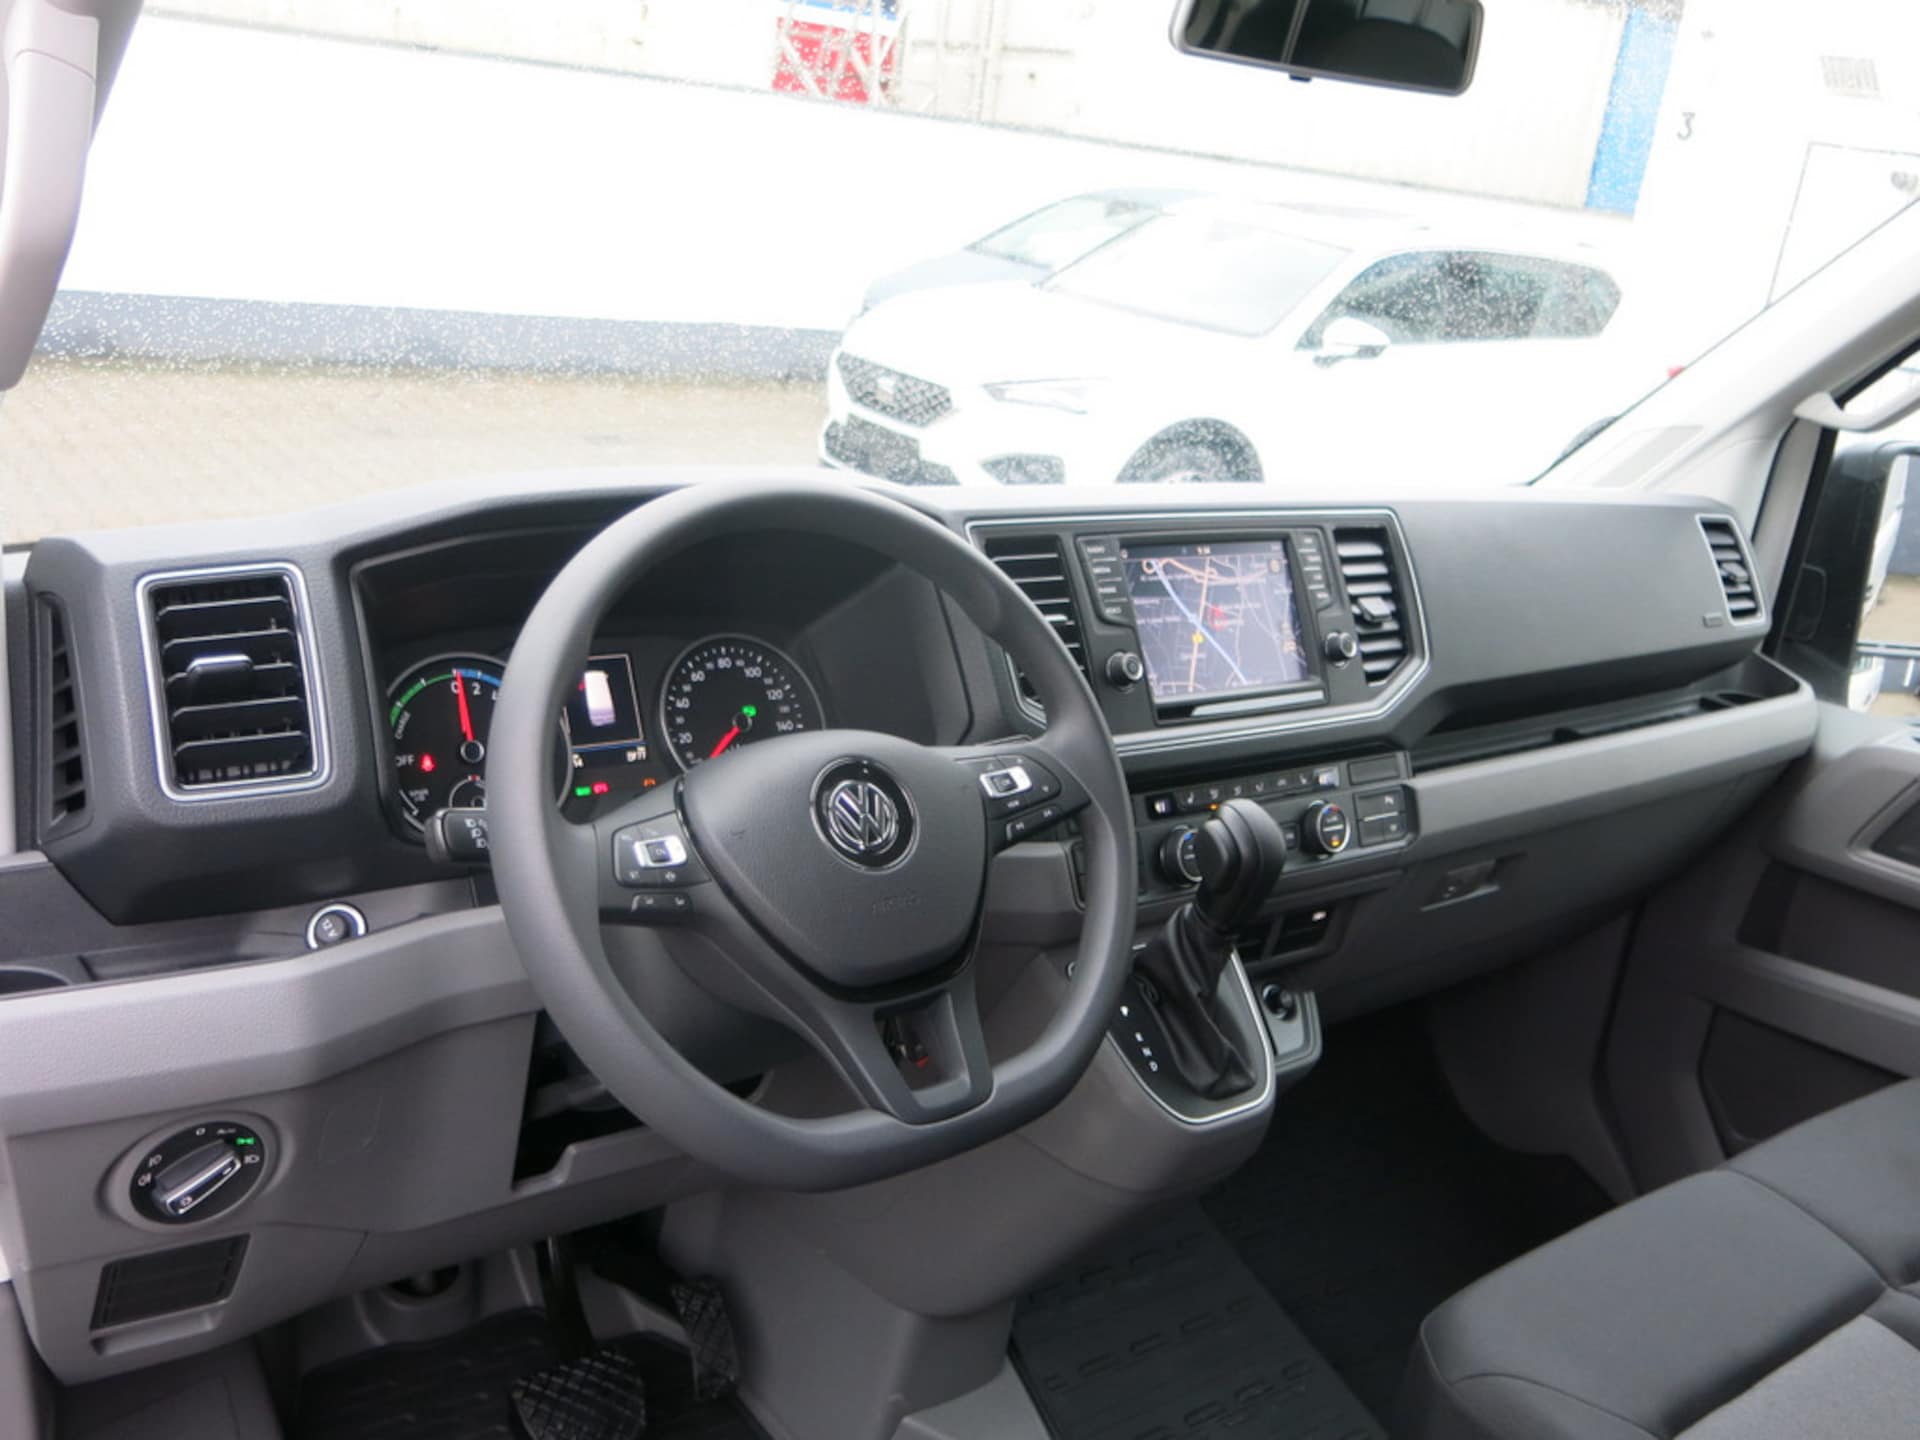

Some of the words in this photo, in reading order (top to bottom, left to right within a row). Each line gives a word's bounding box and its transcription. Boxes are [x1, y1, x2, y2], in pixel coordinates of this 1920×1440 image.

[717, 657, 732, 669] 80
[691, 670, 705, 682] 60
[743, 666, 762, 678] 100
[471, 681, 481, 695] 2
[766, 689, 783, 700] 120
[675, 698, 690, 708] 40
[776, 720, 794, 732] 140
[679, 732, 693, 744] 20
